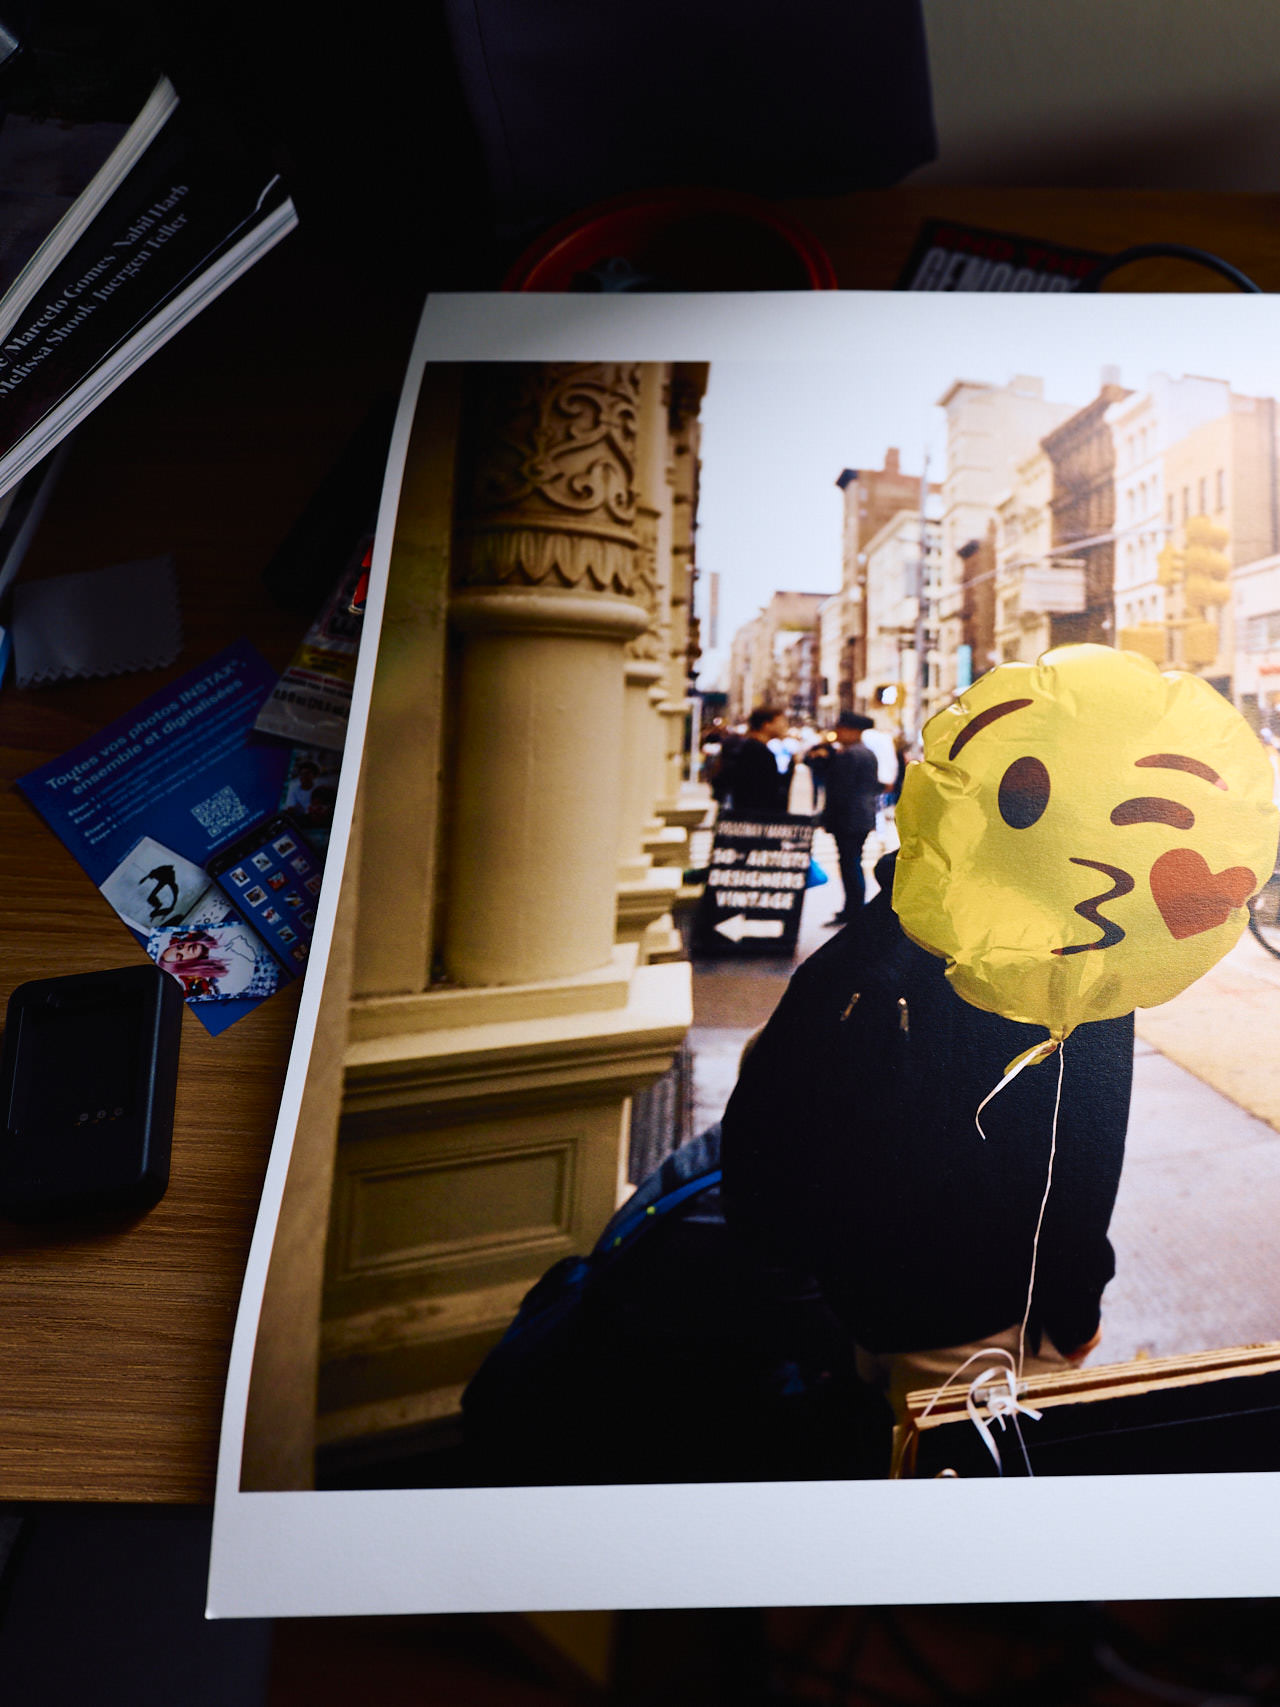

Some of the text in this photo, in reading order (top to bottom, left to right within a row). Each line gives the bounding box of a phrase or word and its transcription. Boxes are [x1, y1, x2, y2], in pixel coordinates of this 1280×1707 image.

[46, 303, 97, 346] Shook
[143, 212, 188, 250] Teller
[63, 254, 117, 300] Gomes
[99, 736, 128, 758] vos
[127, 700, 180, 741] photos
[72, 743, 143, 795] ensemble
[143, 730, 160, 746] et
[708, 869, 805, 889] DESIGNERS
[716, 890, 795, 910] VINTAGE
